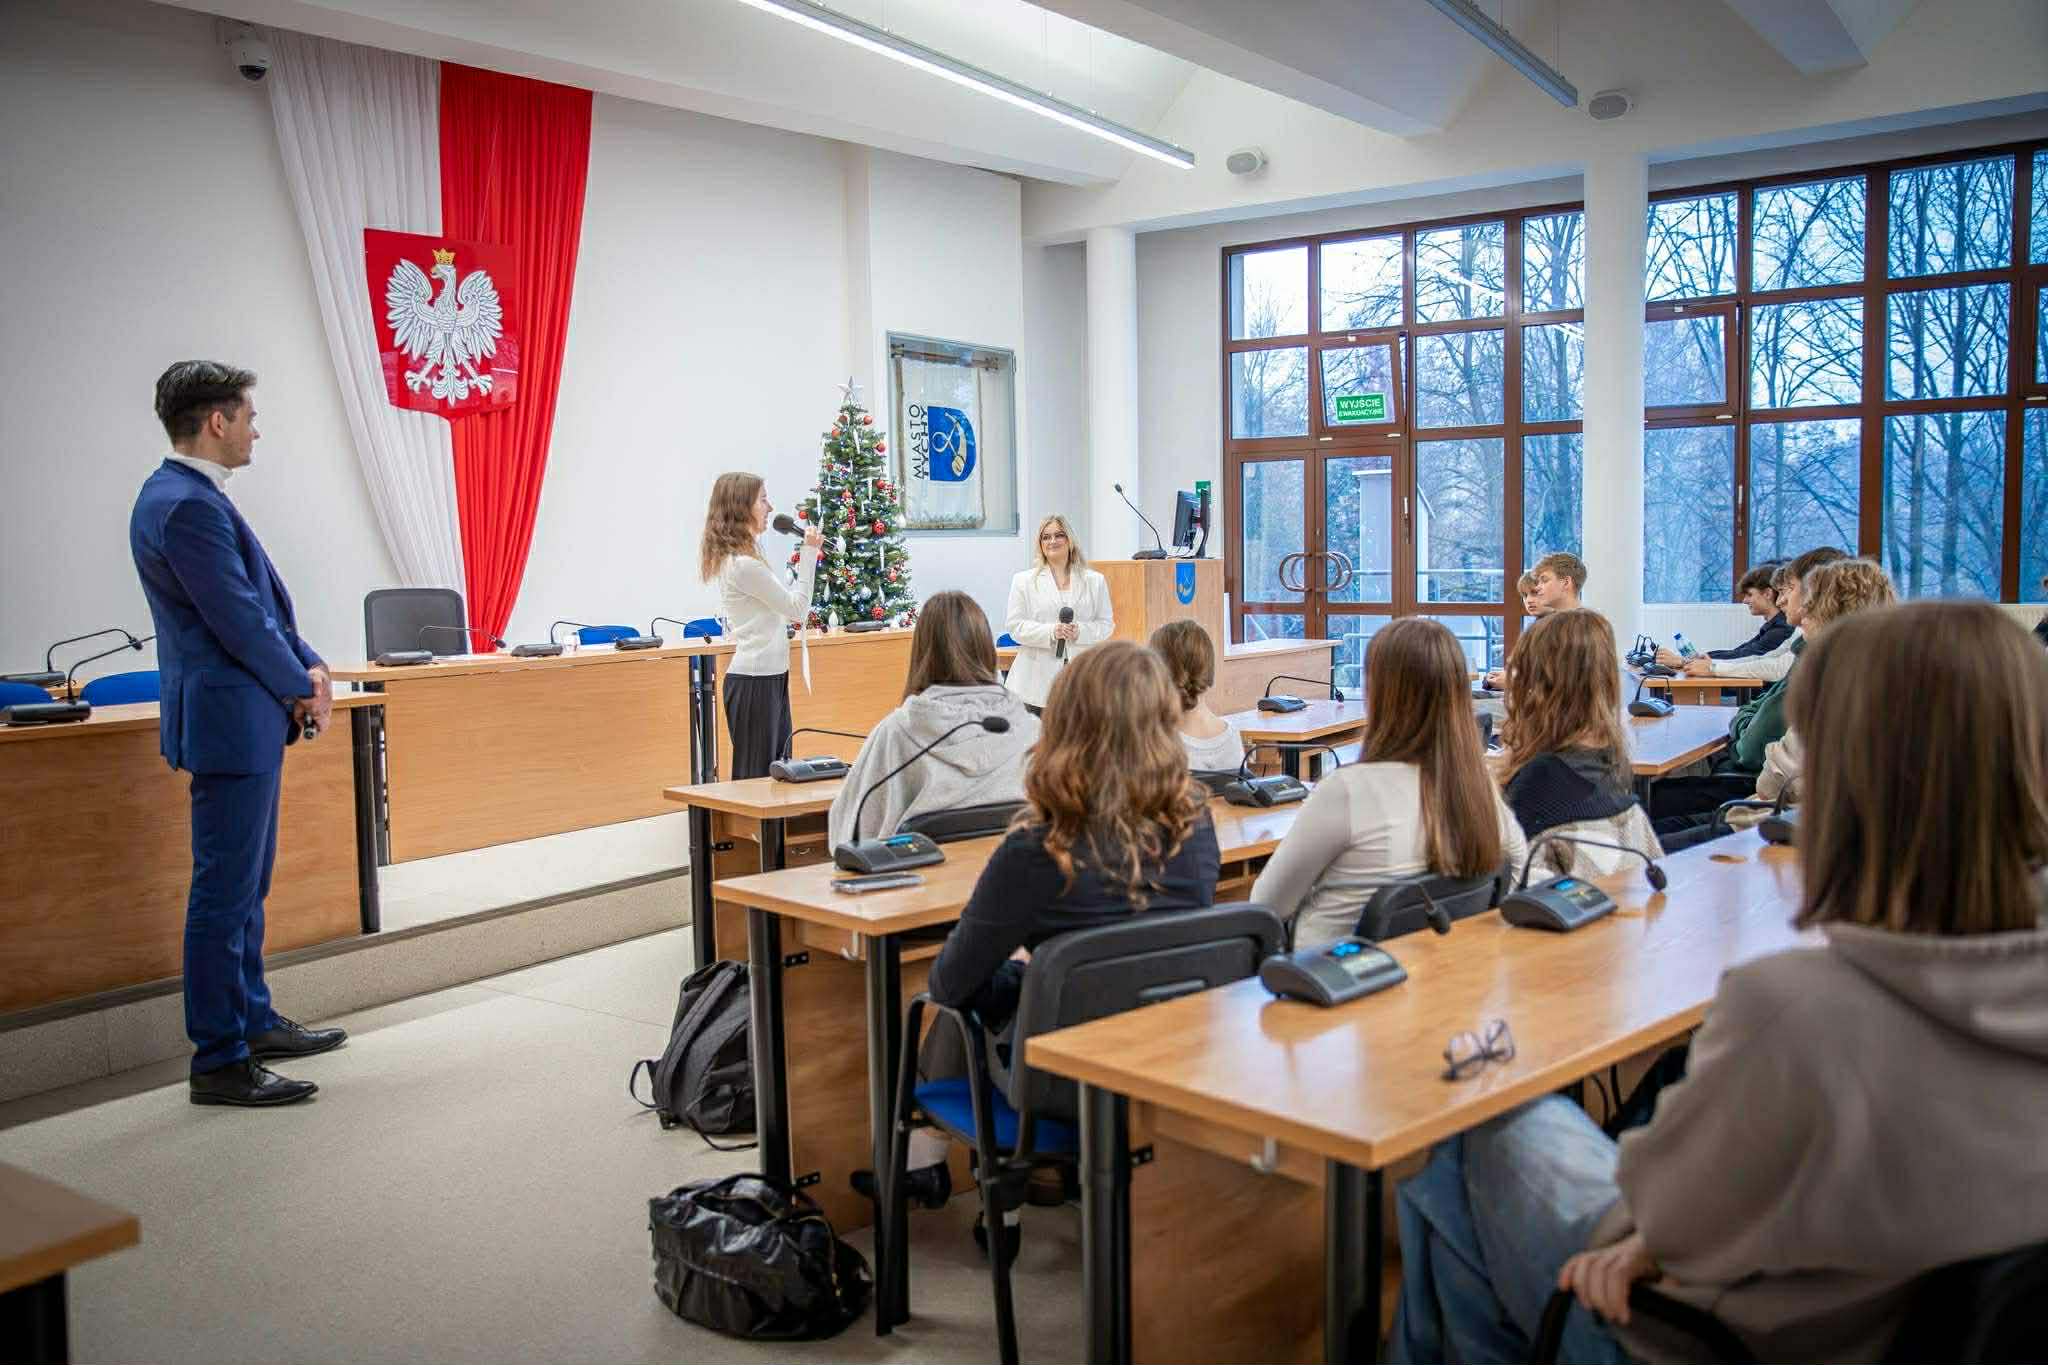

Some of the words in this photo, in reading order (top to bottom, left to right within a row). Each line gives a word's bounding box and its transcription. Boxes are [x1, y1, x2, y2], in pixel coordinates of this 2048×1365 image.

[1339, 398, 1381, 409] WYJŚCIE
[908, 404, 923, 480] MIASTO
[920, 405, 929, 480] TYCHY
